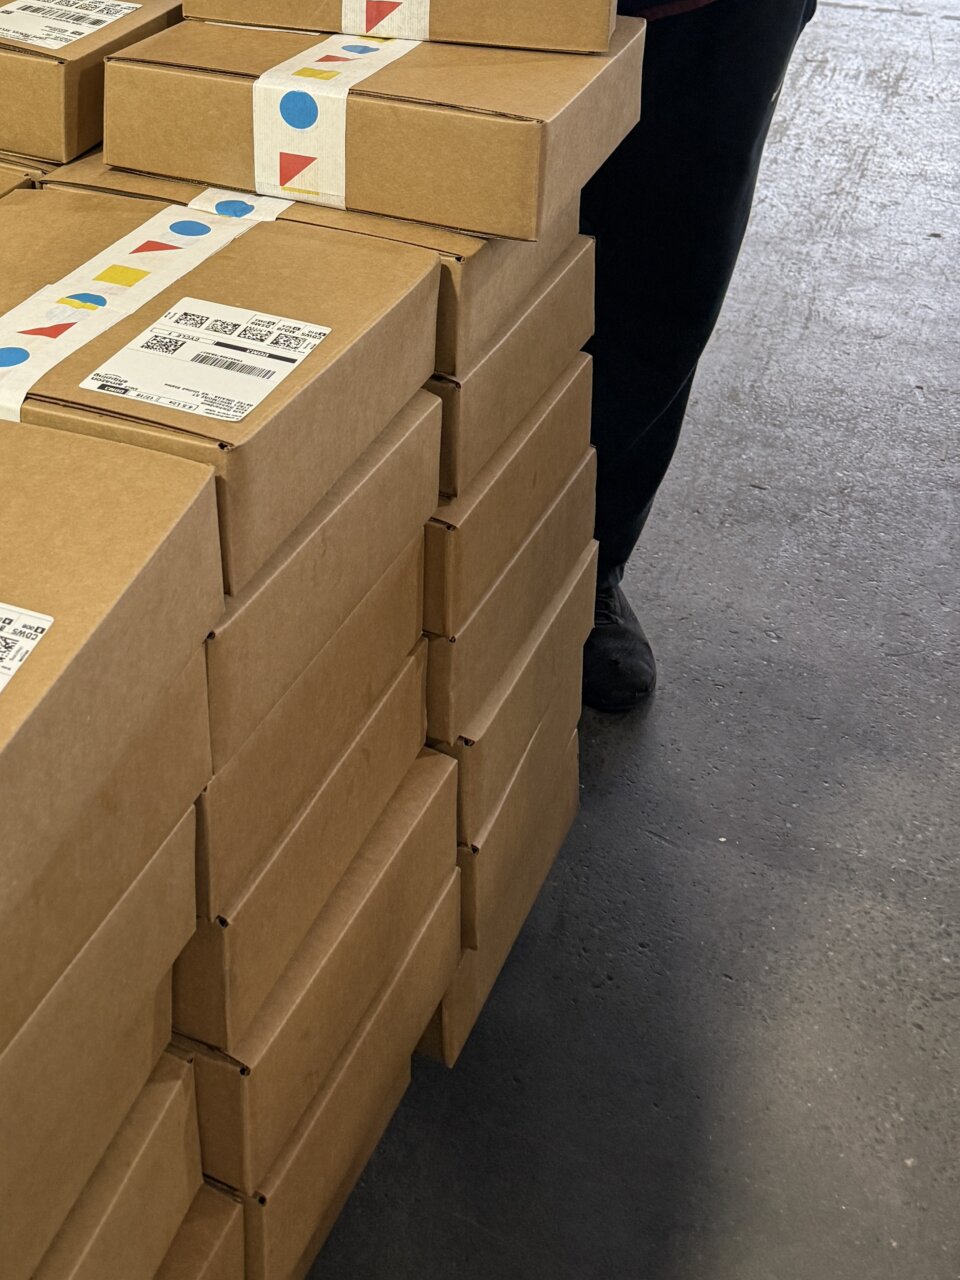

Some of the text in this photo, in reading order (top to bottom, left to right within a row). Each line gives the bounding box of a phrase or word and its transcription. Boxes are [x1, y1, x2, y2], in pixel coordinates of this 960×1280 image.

[175, 333, 200, 342] CYCLE
[89, 376, 124, 386] amazon
[91, 372, 129, 383] shipping
[9, 627, 39, 640] CDW5
